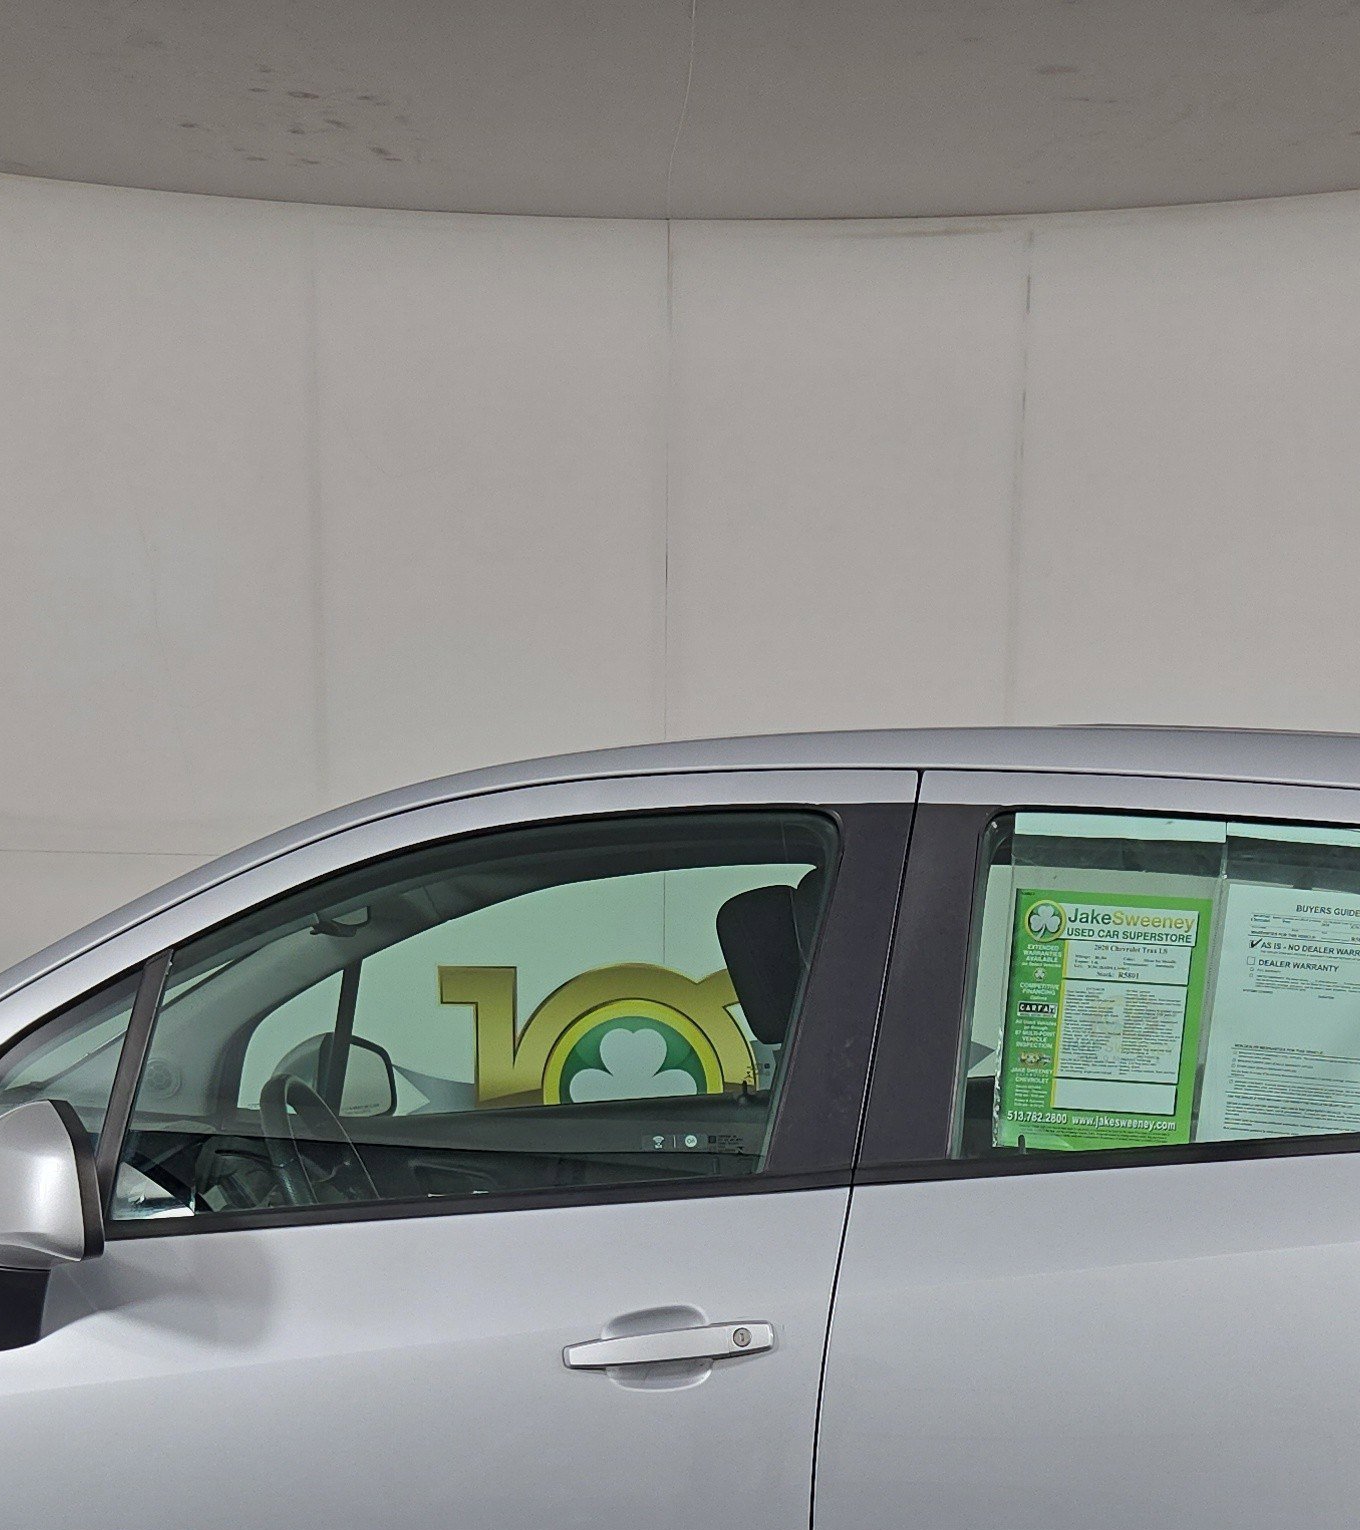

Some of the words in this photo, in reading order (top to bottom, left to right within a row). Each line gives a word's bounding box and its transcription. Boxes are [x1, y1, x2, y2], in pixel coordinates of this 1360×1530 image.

[1296, 904, 1332, 915] BUYERS
[1333, 907, 1360, 917] GUIDE
[1066, 928, 1095, 938] USED
[1097, 929, 1120, 939] CAR
[1122, 931, 1192, 943] SUPERSTORE
[1260, 941, 1272, 949] AS
[1288, 943, 1301, 952] NO
[1301, 945, 1335, 955] DEALER
[1258, 959, 1291, 969] DEALER
[1292, 961, 1340, 973] WARRANTY
